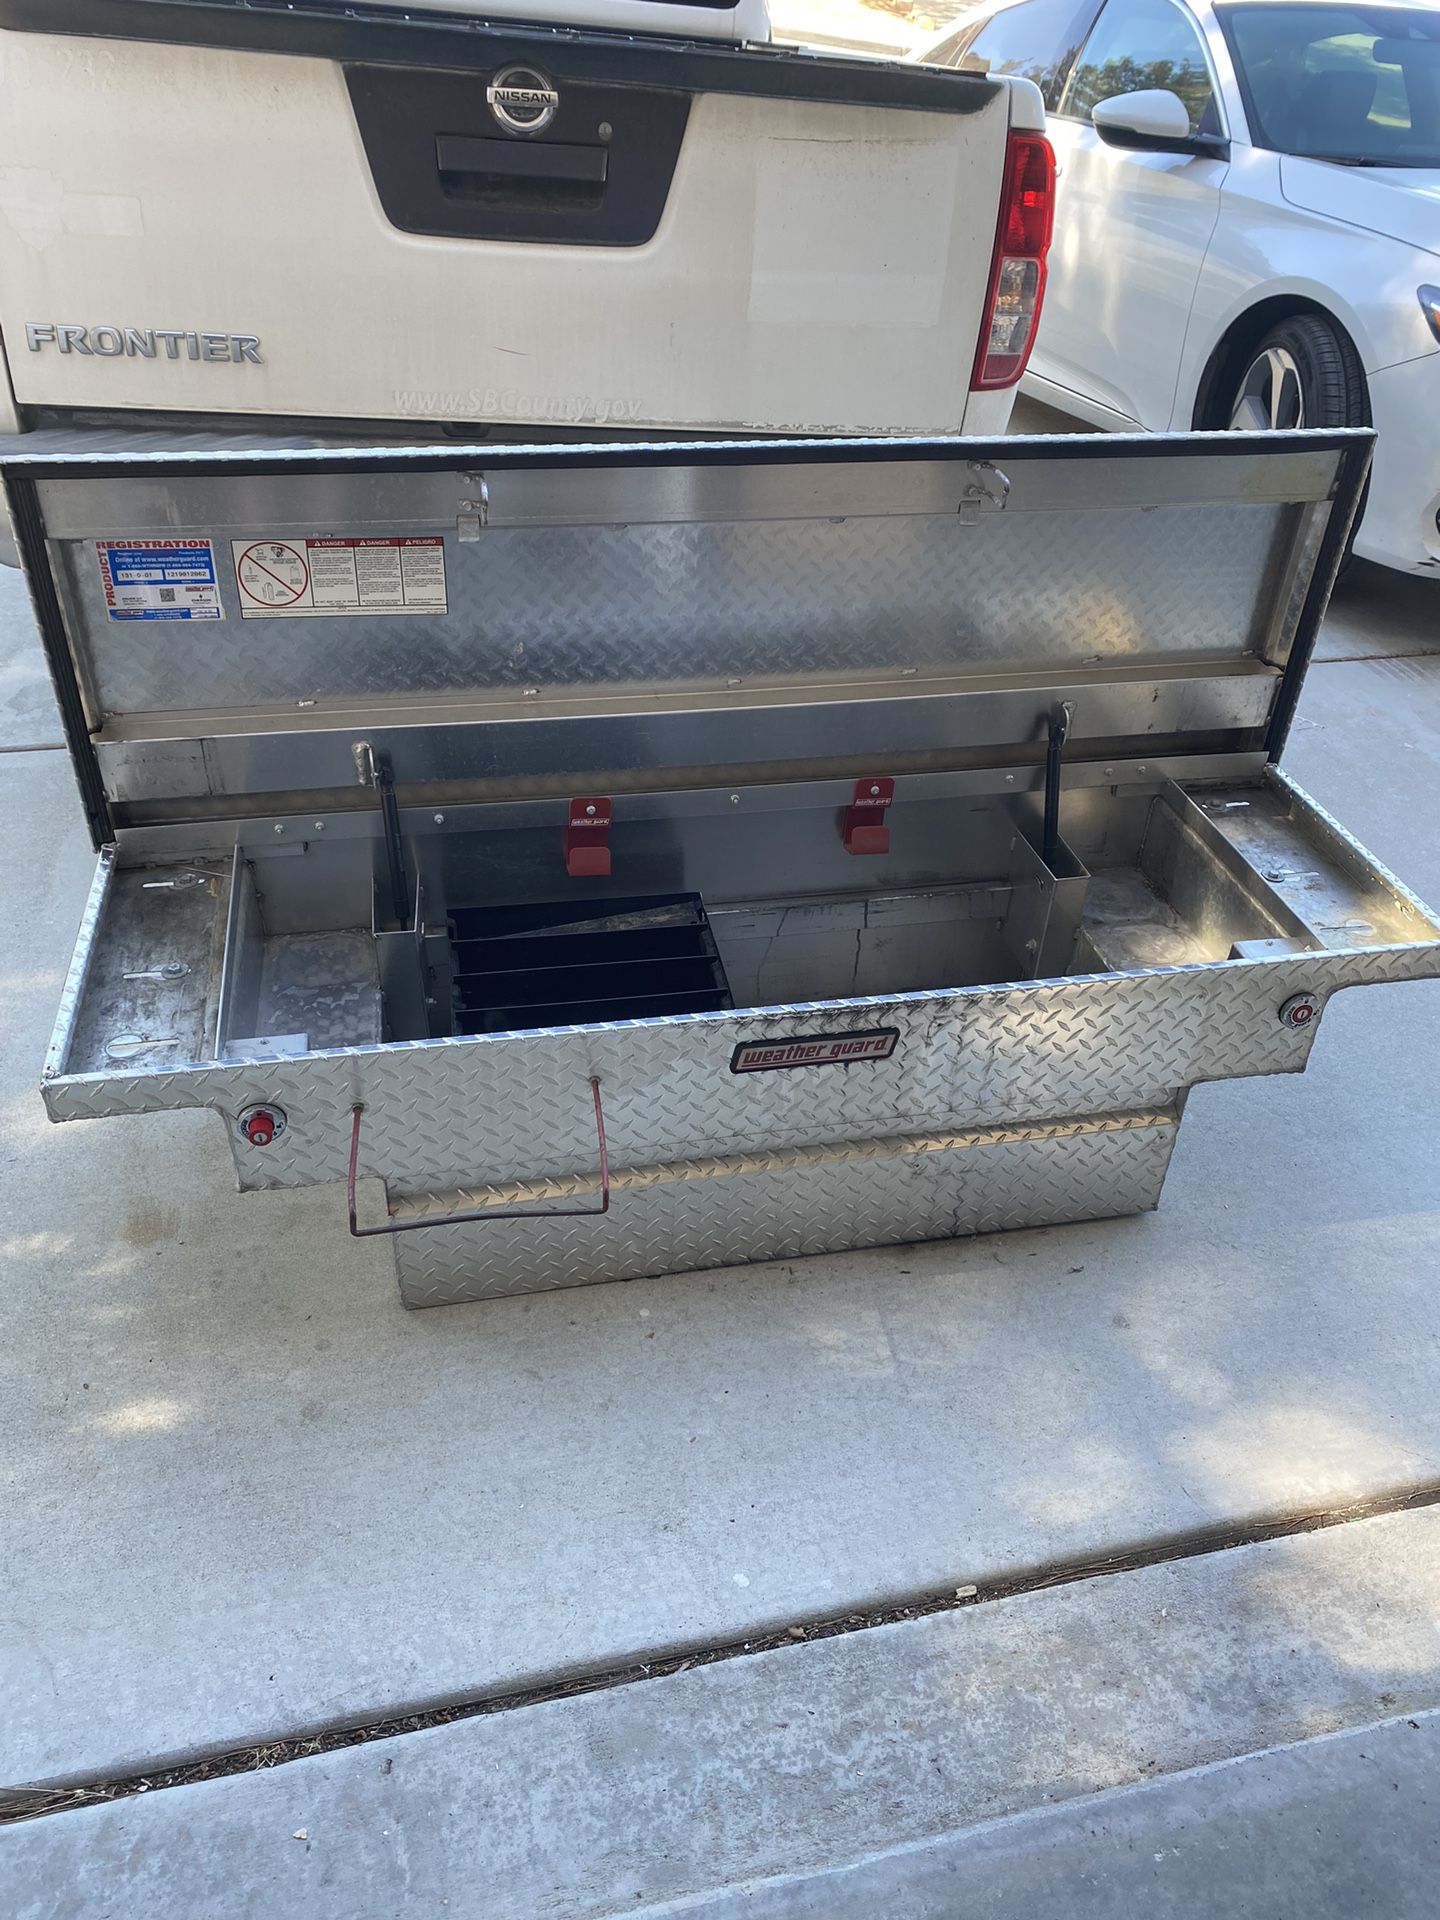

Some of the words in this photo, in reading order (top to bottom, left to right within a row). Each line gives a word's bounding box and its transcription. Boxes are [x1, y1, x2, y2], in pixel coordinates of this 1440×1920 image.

[494, 90, 552, 103] NISSAN
[25, 321, 264, 365] FRONTIER
[95, 540, 210, 549] REGISTRATION
[97, 550, 117, 607] PRODUCT
[743, 1044, 828, 1064] weather
[829, 1036, 887, 1058] guard
